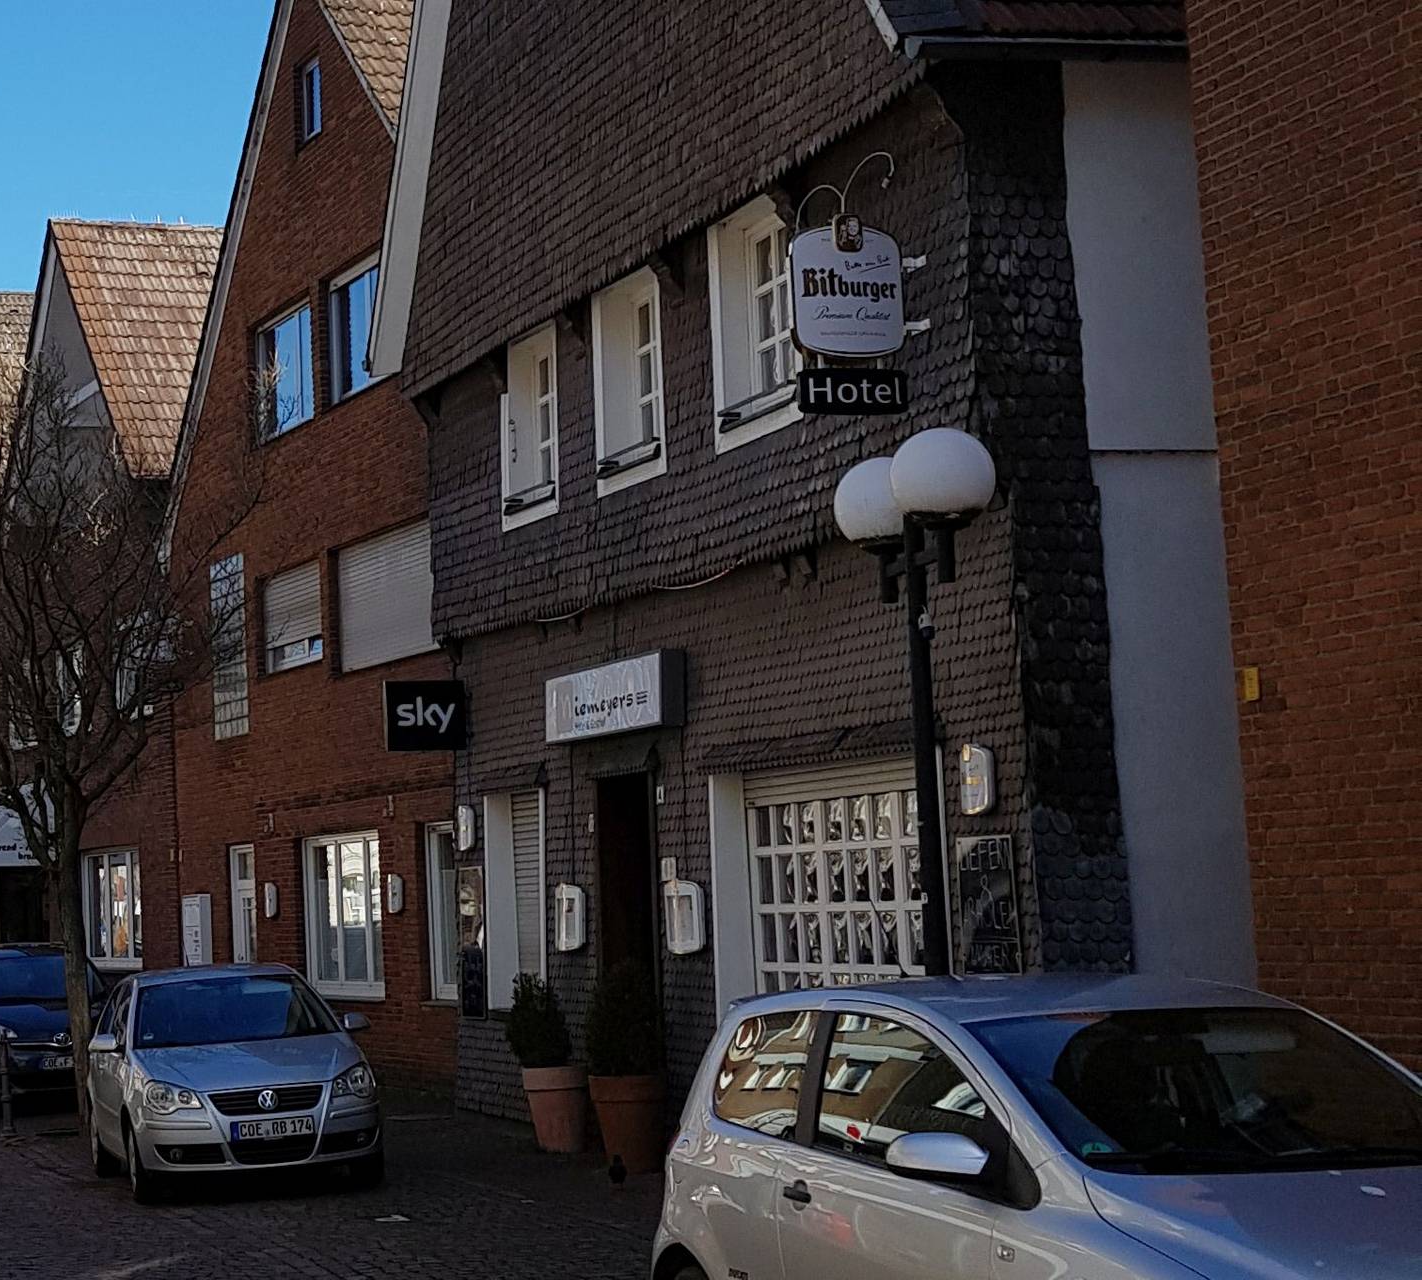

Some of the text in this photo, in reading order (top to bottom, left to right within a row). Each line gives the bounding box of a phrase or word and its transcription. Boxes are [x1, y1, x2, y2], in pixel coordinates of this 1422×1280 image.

[801, 267, 898, 303] Bitburger
[808, 376, 903, 405] Hotel
[396, 696, 456, 734] sky
[240, 1119, 312, 1137] COE RB 174
